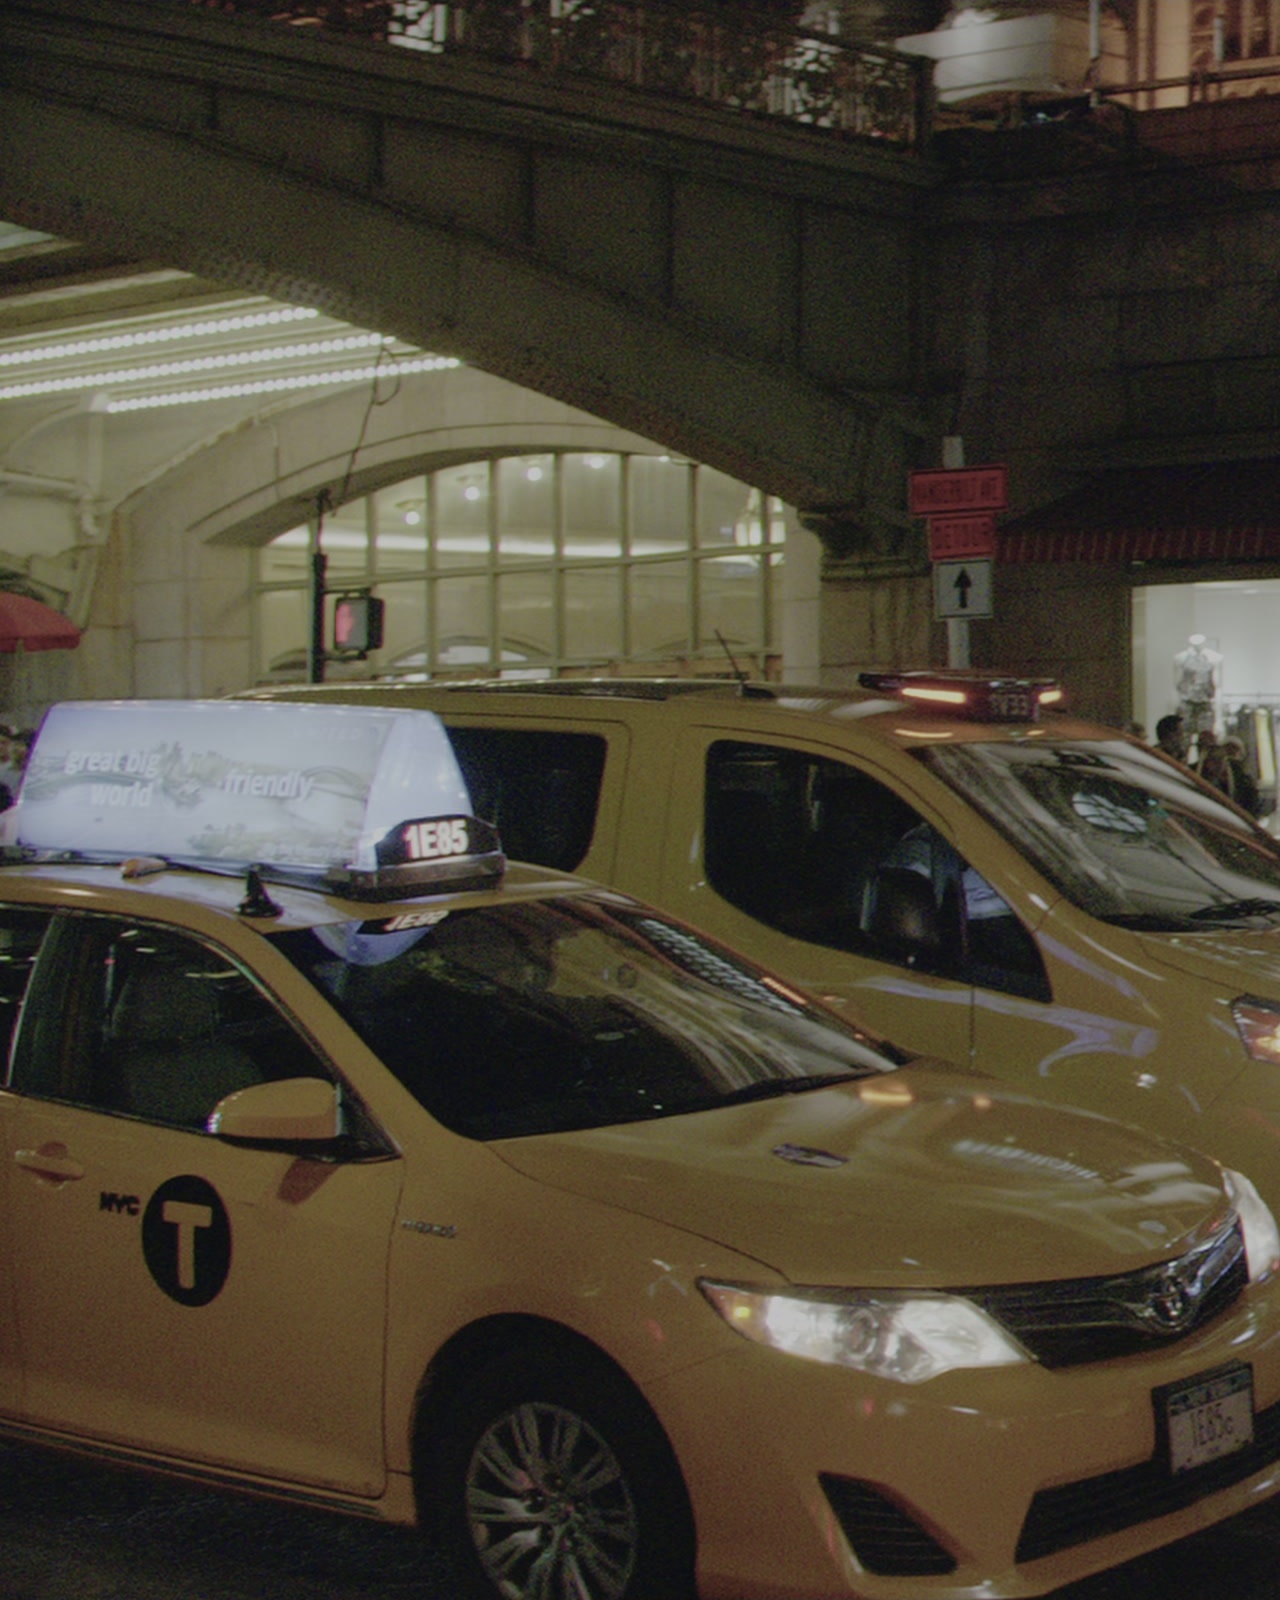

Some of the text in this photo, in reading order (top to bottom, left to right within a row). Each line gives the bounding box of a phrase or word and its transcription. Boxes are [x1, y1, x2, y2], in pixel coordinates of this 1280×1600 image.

[934, 522, 991, 550] DETOUR
[65, 749, 162, 779] great big
[90, 782, 153, 807] world
[404, 819, 469, 859] 1E85
[100, 1191, 140, 1216] NYC
[162, 1200, 213, 1290] T
